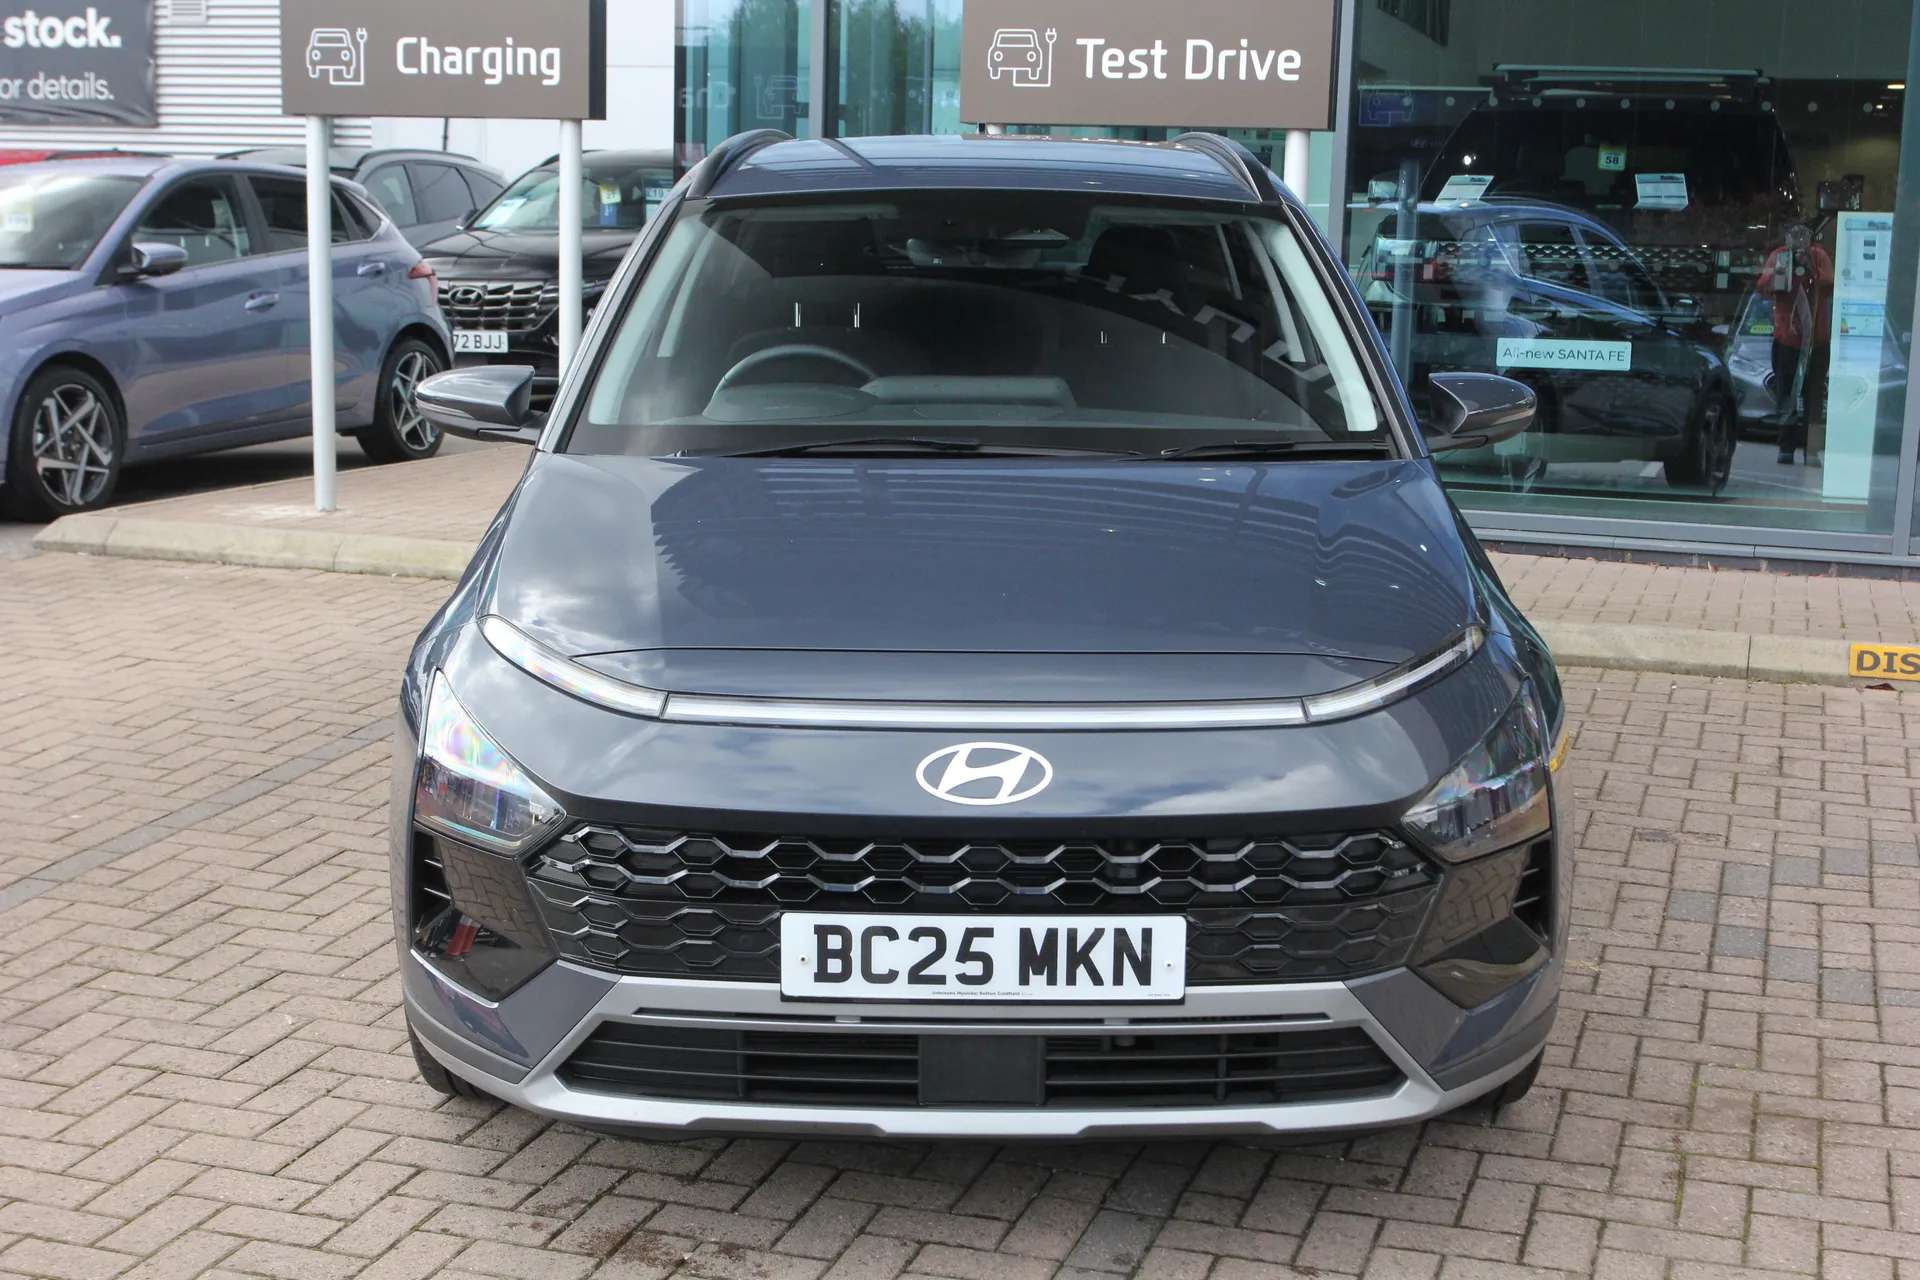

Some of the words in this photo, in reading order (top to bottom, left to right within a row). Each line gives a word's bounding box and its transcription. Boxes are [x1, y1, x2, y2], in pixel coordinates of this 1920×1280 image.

[4, 7, 122, 48] stock.
[396, 36, 561, 86] Charging
[1076, 38, 1168, 81] Test
[1185, 38, 1302, 82] Drive
[0, 77, 23, 99] or
[27, 72, 115, 100] details.
[474, 334, 502, 349] BJJ
[1503, 346, 1554, 360] All-new
[1557, 349, 1605, 361] SANTA
[1608, 350, 1625, 362] FE
[1857, 650, 1920, 674] DIS
[813, 924, 994, 985] BC25
[1018, 927, 1153, 986] MKN
